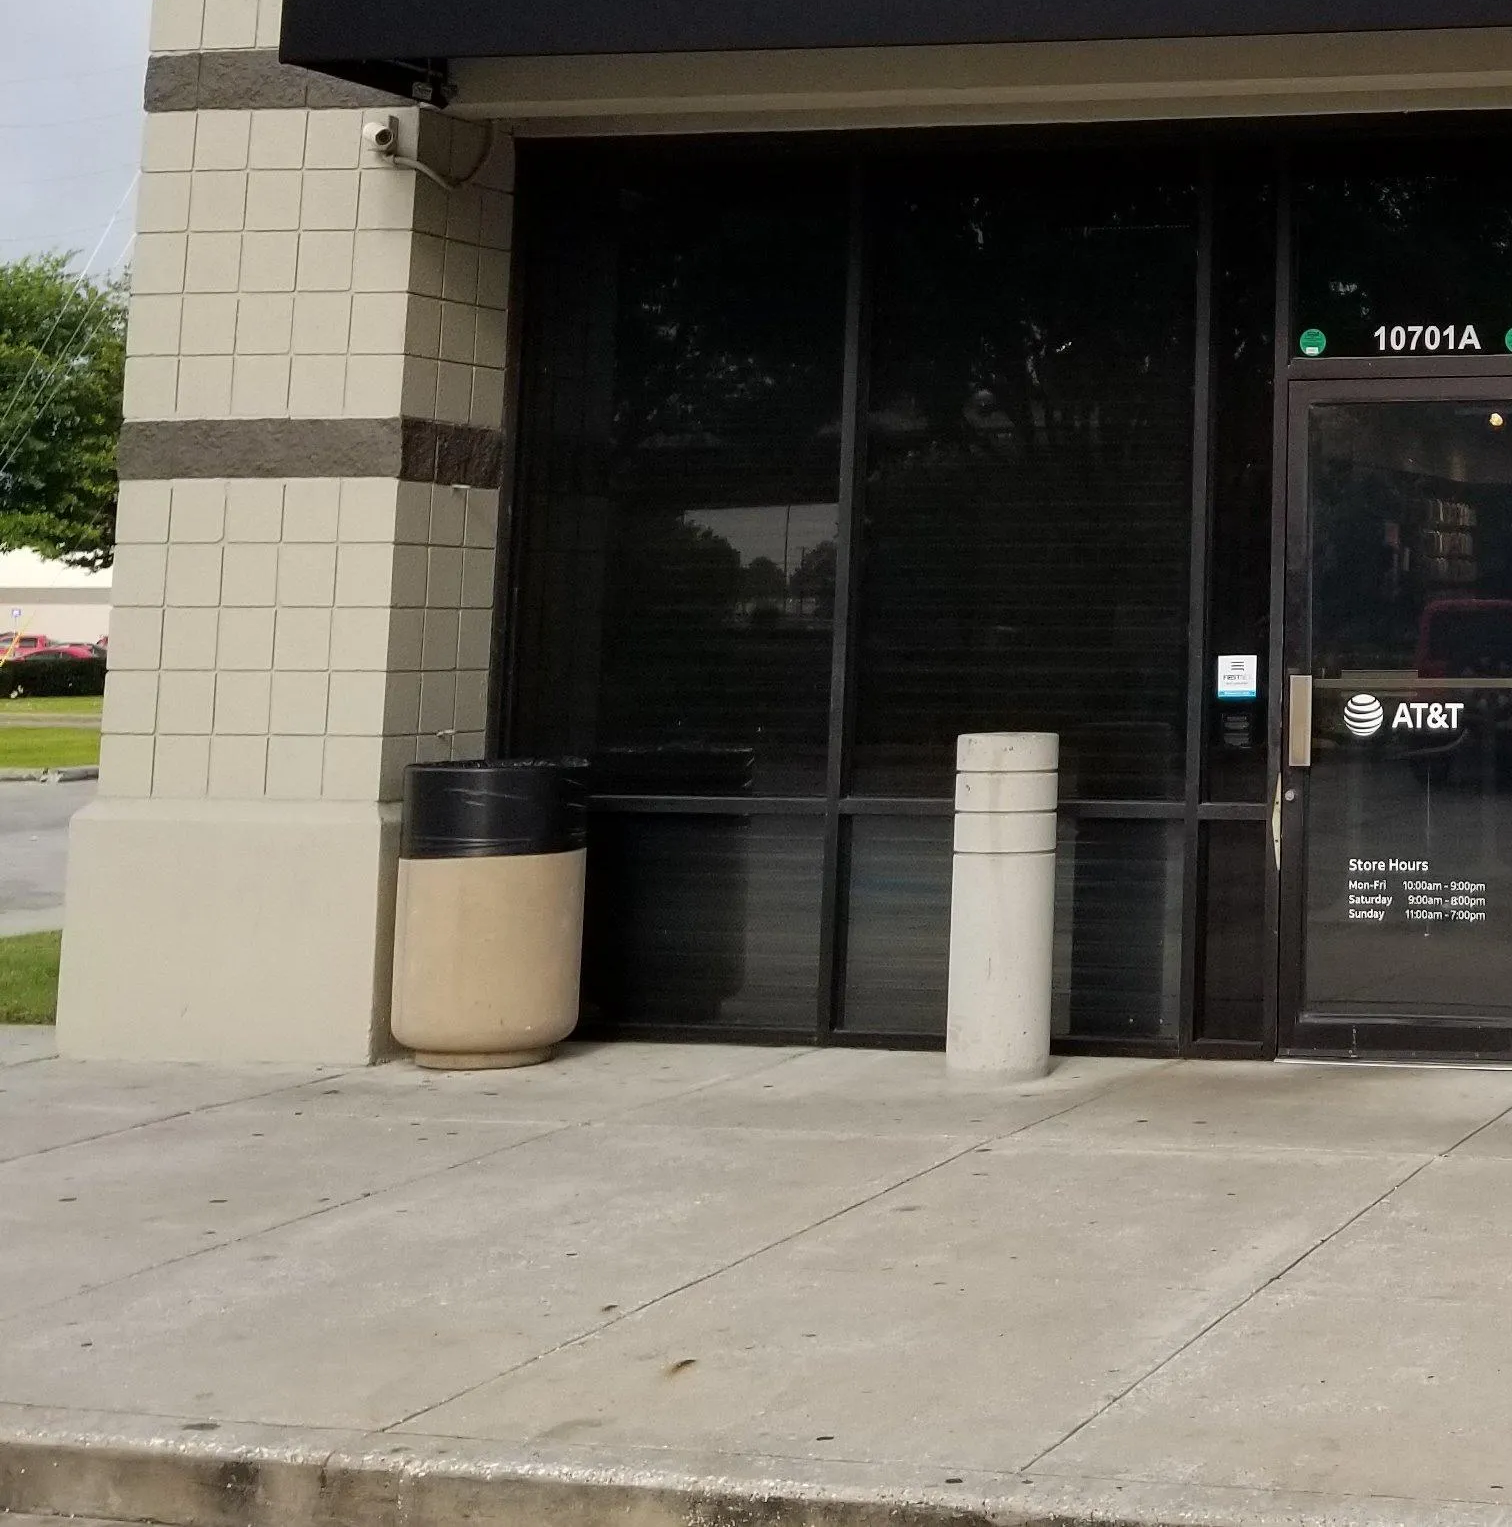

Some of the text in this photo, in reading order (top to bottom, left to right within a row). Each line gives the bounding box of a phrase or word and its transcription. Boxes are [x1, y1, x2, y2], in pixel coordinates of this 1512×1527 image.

[1374, 324, 1482, 351] 10701A
[1391, 702, 1465, 729] AT&T
[1348, 858, 1429, 872] Store Hours
[1348, 880, 1387, 890] Mon-Fri
[1402, 881, 1442, 891] 10:00am
[1450, 881, 1486, 893] 9:00pm
[1348, 894, 1393, 906] Saturday
[1407, 895, 1443, 905] 9:00am
[1450, 895, 1486, 908] 8:00pm
[1348, 909, 1385, 921] Sunday
[1405, 910, 1443, 920] 11:00am
[1450, 910, 1486, 922] 7:00pm
